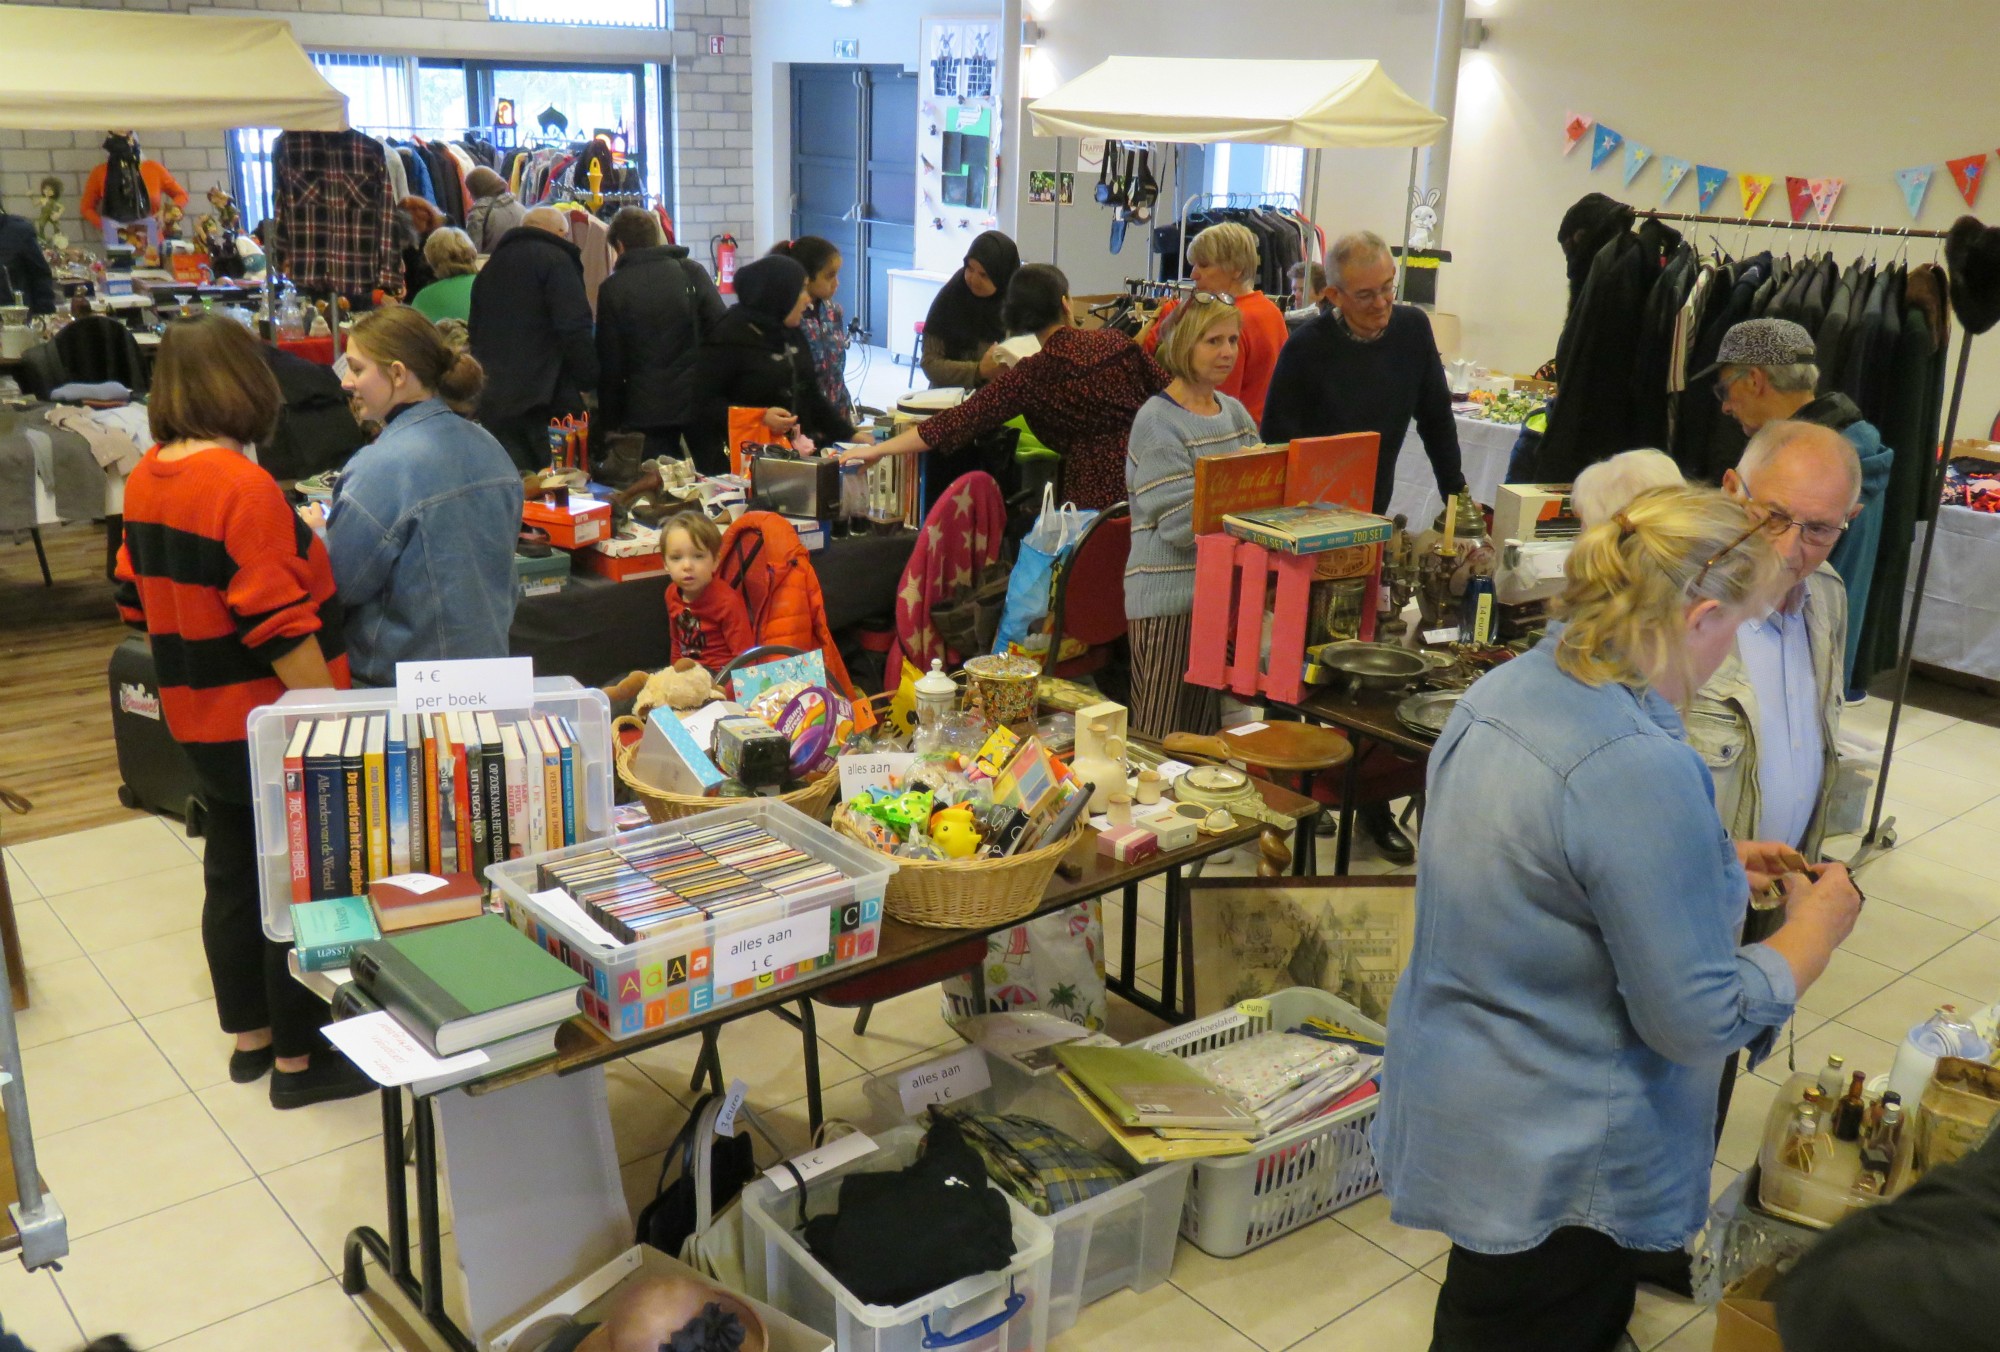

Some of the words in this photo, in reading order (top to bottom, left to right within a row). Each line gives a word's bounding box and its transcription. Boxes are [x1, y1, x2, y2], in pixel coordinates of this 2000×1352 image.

[1269, 538, 1283, 550] SET
[1352, 531, 1367, 543] ZOO
[1370, 529, 1384, 541] SET
[1479, 603, 1487, 617] 14
[1476, 617, 1485, 637] euro
[414, 671, 424, 683] 4
[430, 670, 441, 683] €
[416, 696, 442, 710] per
[449, 692, 487, 706] boek
[410, 755, 419, 775] ONZE
[488, 763, 499, 775] OP
[848, 763, 867, 775] alles
[870, 763, 890, 773] aan
[317, 774, 331, 794] Alle
[346, 772, 359, 785] De
[470, 768, 480, 782] UIT
[471, 784, 480, 794] IN
[489, 775, 500, 795] ZOEK
[549, 771, 558, 805] VERSTERK
[288, 797, 303, 819] ABC
[318, 795, 332, 825] landen
[347, 786, 360, 816] wereld
[411, 776, 421, 829] MYSTERIEUZE
[472, 795, 481, 819] EIGEN
[490, 795, 501, 819] NAAR
[551, 807, 558, 818] UW
[321, 825, 330, 843] van
[349, 817, 359, 834] van
[473, 820, 483, 843] LAND
[491, 819, 501, 834] HET
[321, 843, 334, 856] de
[350, 834, 362, 849] het
[322, 856, 336, 891] Wereld
[620, 977, 640, 998] A
[668, 960, 686, 982] A
[693, 955, 708, 971] a
[843, 906, 857, 926] C
[864, 900, 879, 919] D
[730, 936, 762, 956] alles
[767, 928, 792, 944] aan
[317, 945, 354, 960] Vissen
[751, 960, 757, 972] 1
[763, 954, 773, 968] €
[693, 988, 708, 1009] E
[1246, 1004, 1263, 1012] euro
[1151, 1014, 1238, 1052] eenpersoonshoeslaken
[912, 1073, 939, 1089] alles
[941, 1064, 961, 1079] aan
[934, 1092, 941, 1102] 1
[944, 1087, 952, 1098] €
[725, 1094, 740, 1120] euro
[721, 1121, 730, 1130] 3
[801, 1162, 810, 1170] 1
[812, 1156, 823, 1165] €
